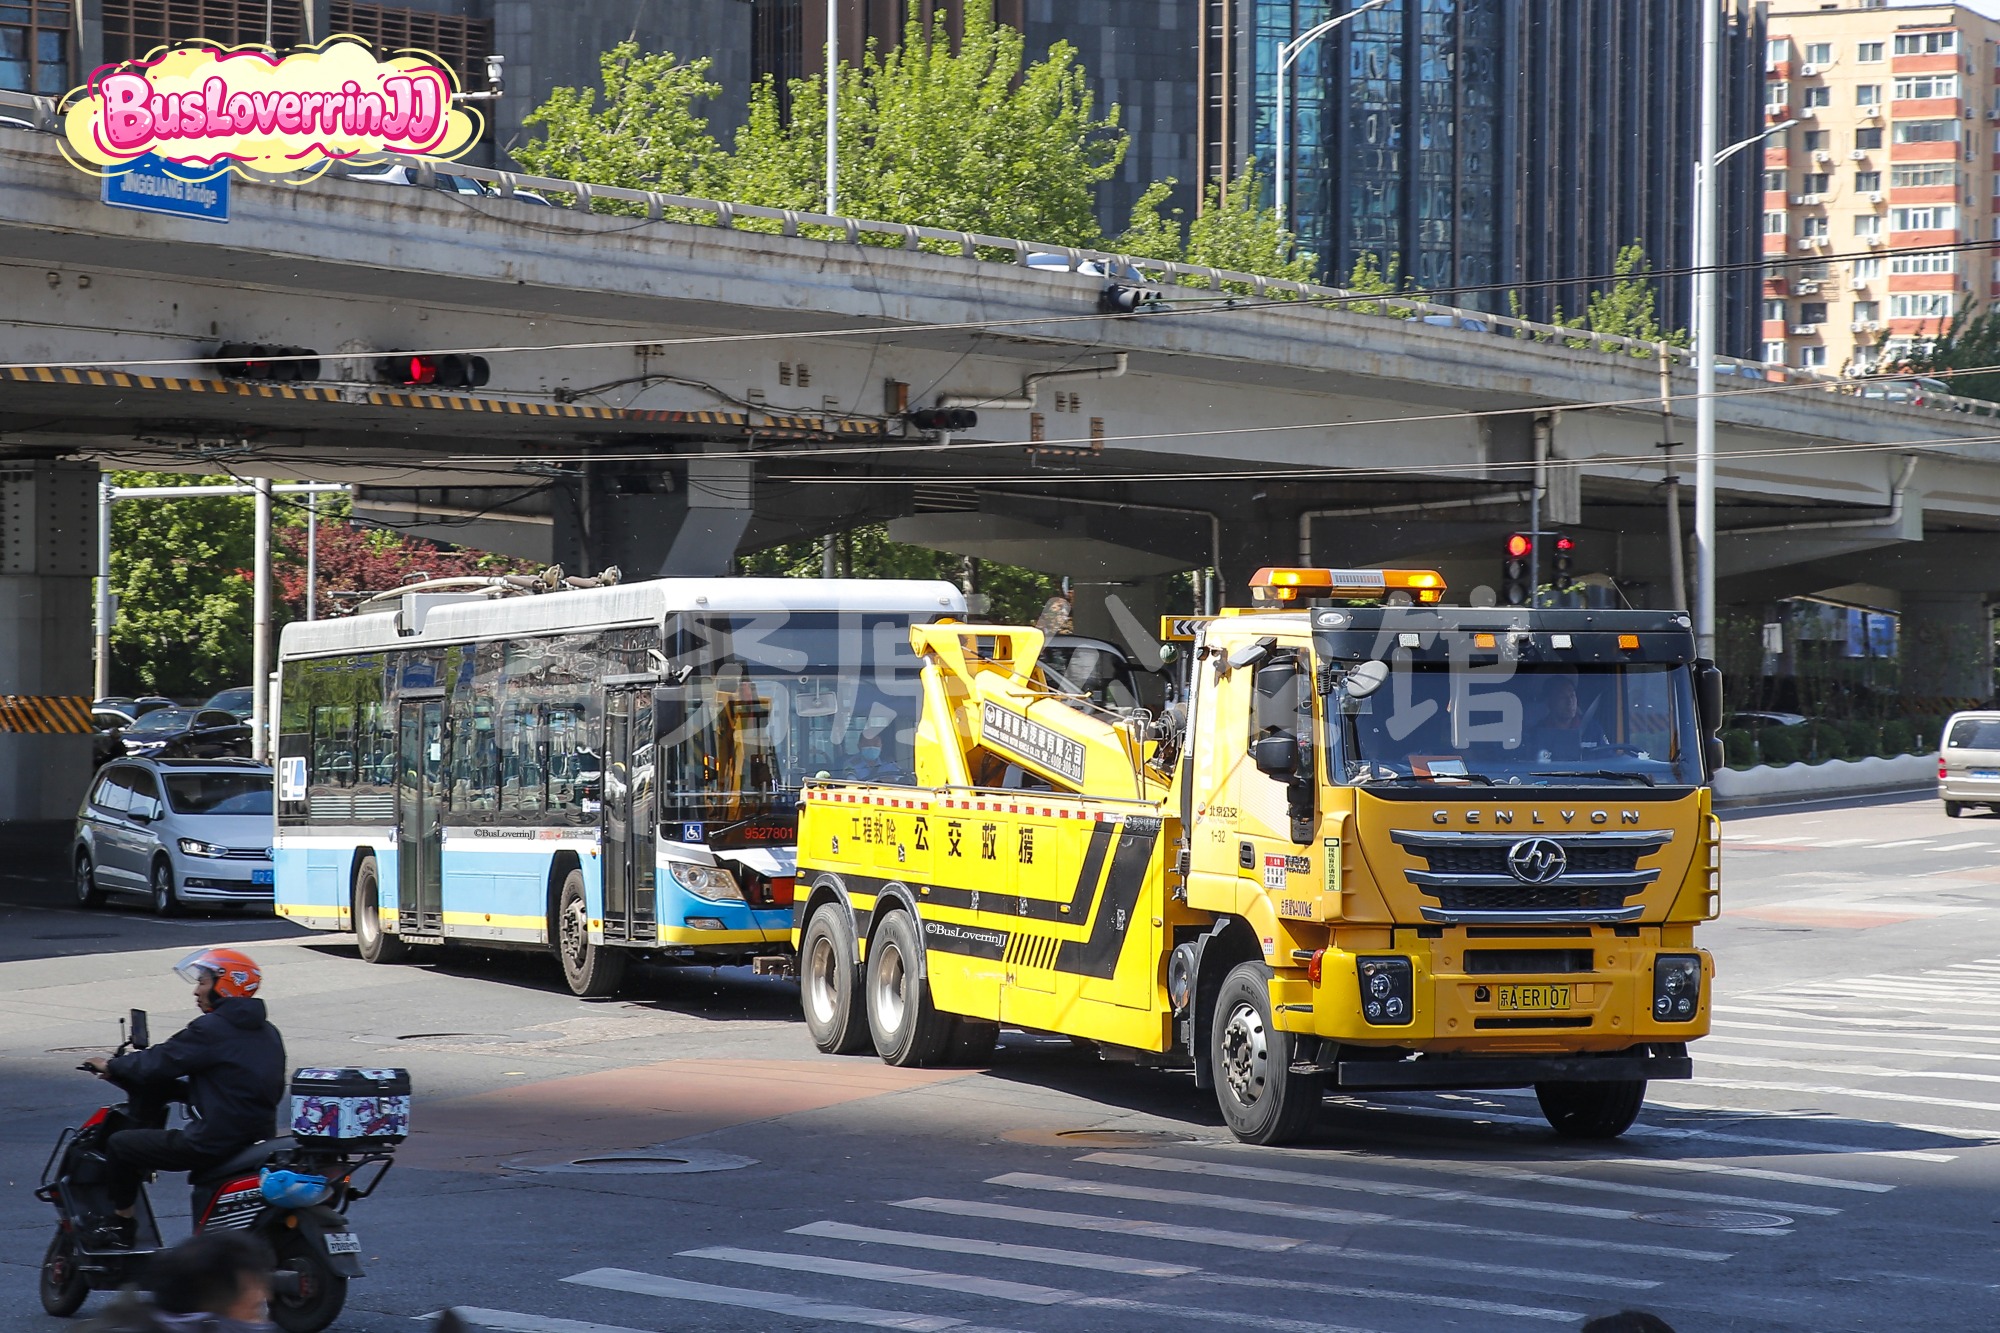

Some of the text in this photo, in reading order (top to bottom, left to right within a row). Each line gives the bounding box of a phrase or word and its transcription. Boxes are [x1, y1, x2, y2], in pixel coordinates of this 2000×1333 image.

[185, 182, 218, 209] Bridge
[1209, 805, 1238, 818] 北京公交
[1433, 810, 1640, 824] GENLYON
[744, 827, 793, 839] 9527801
[852, 813, 897, 846] 工程救险
[1211, 830, 1226, 843] 1-32
[915, 816, 1034, 864] 公交救援
